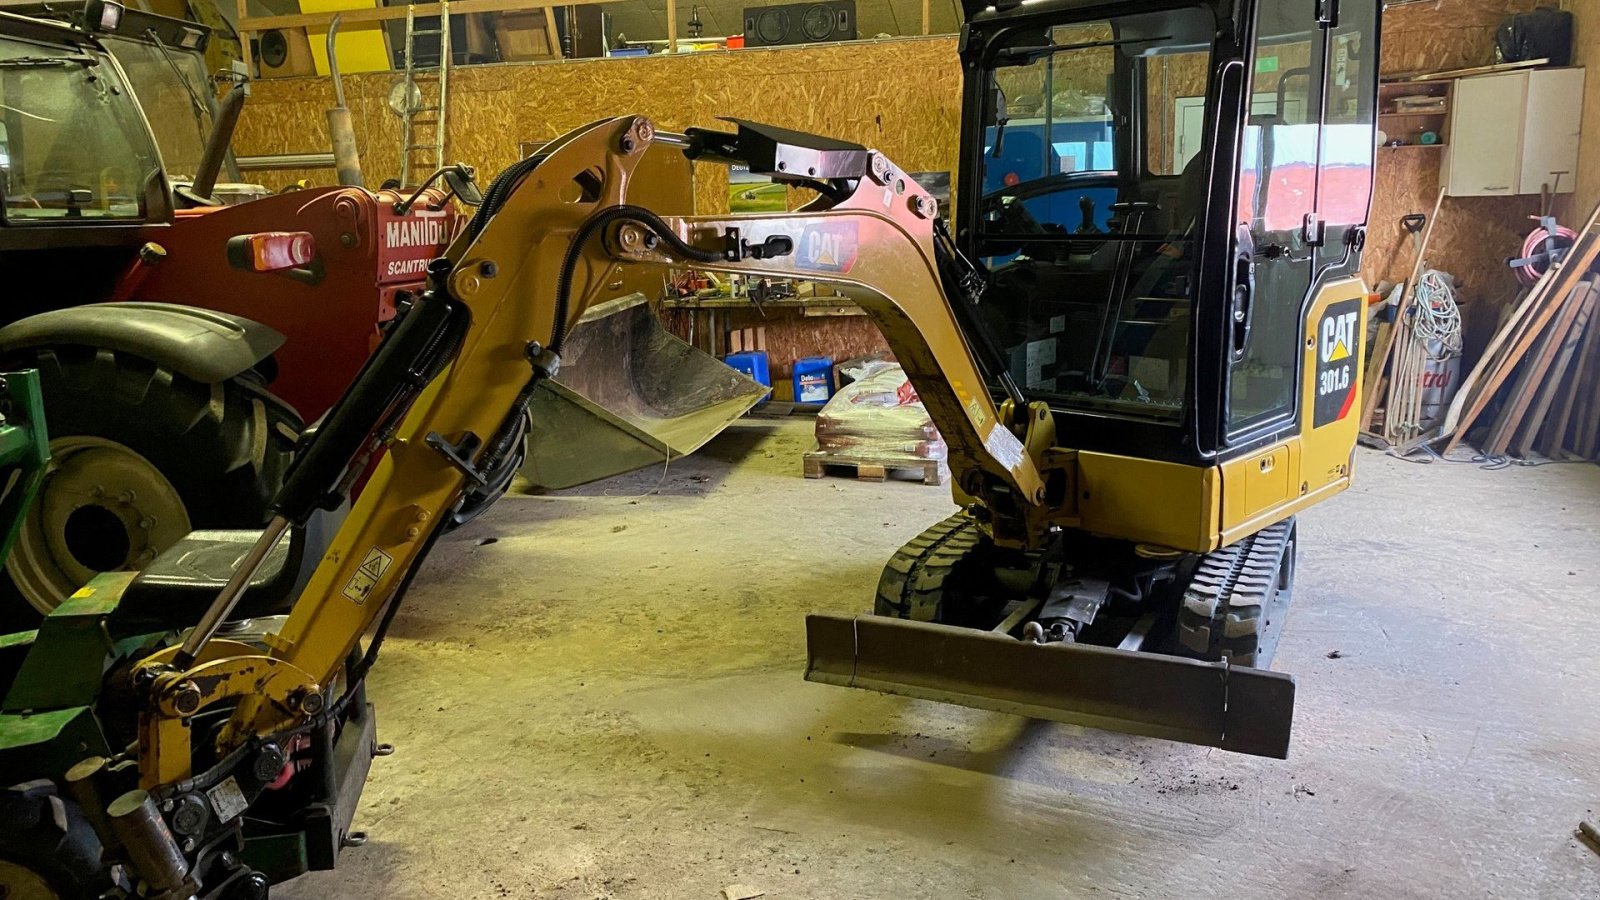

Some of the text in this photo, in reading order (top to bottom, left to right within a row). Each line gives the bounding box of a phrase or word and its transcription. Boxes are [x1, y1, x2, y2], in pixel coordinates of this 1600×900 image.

[386, 210, 447, 248] MANITOU
[808, 231, 843, 265] CAT
[1321, 312, 1357, 363] CAT
[1320, 365, 1350, 396] 301.6
[1416, 369, 1452, 388] trol
